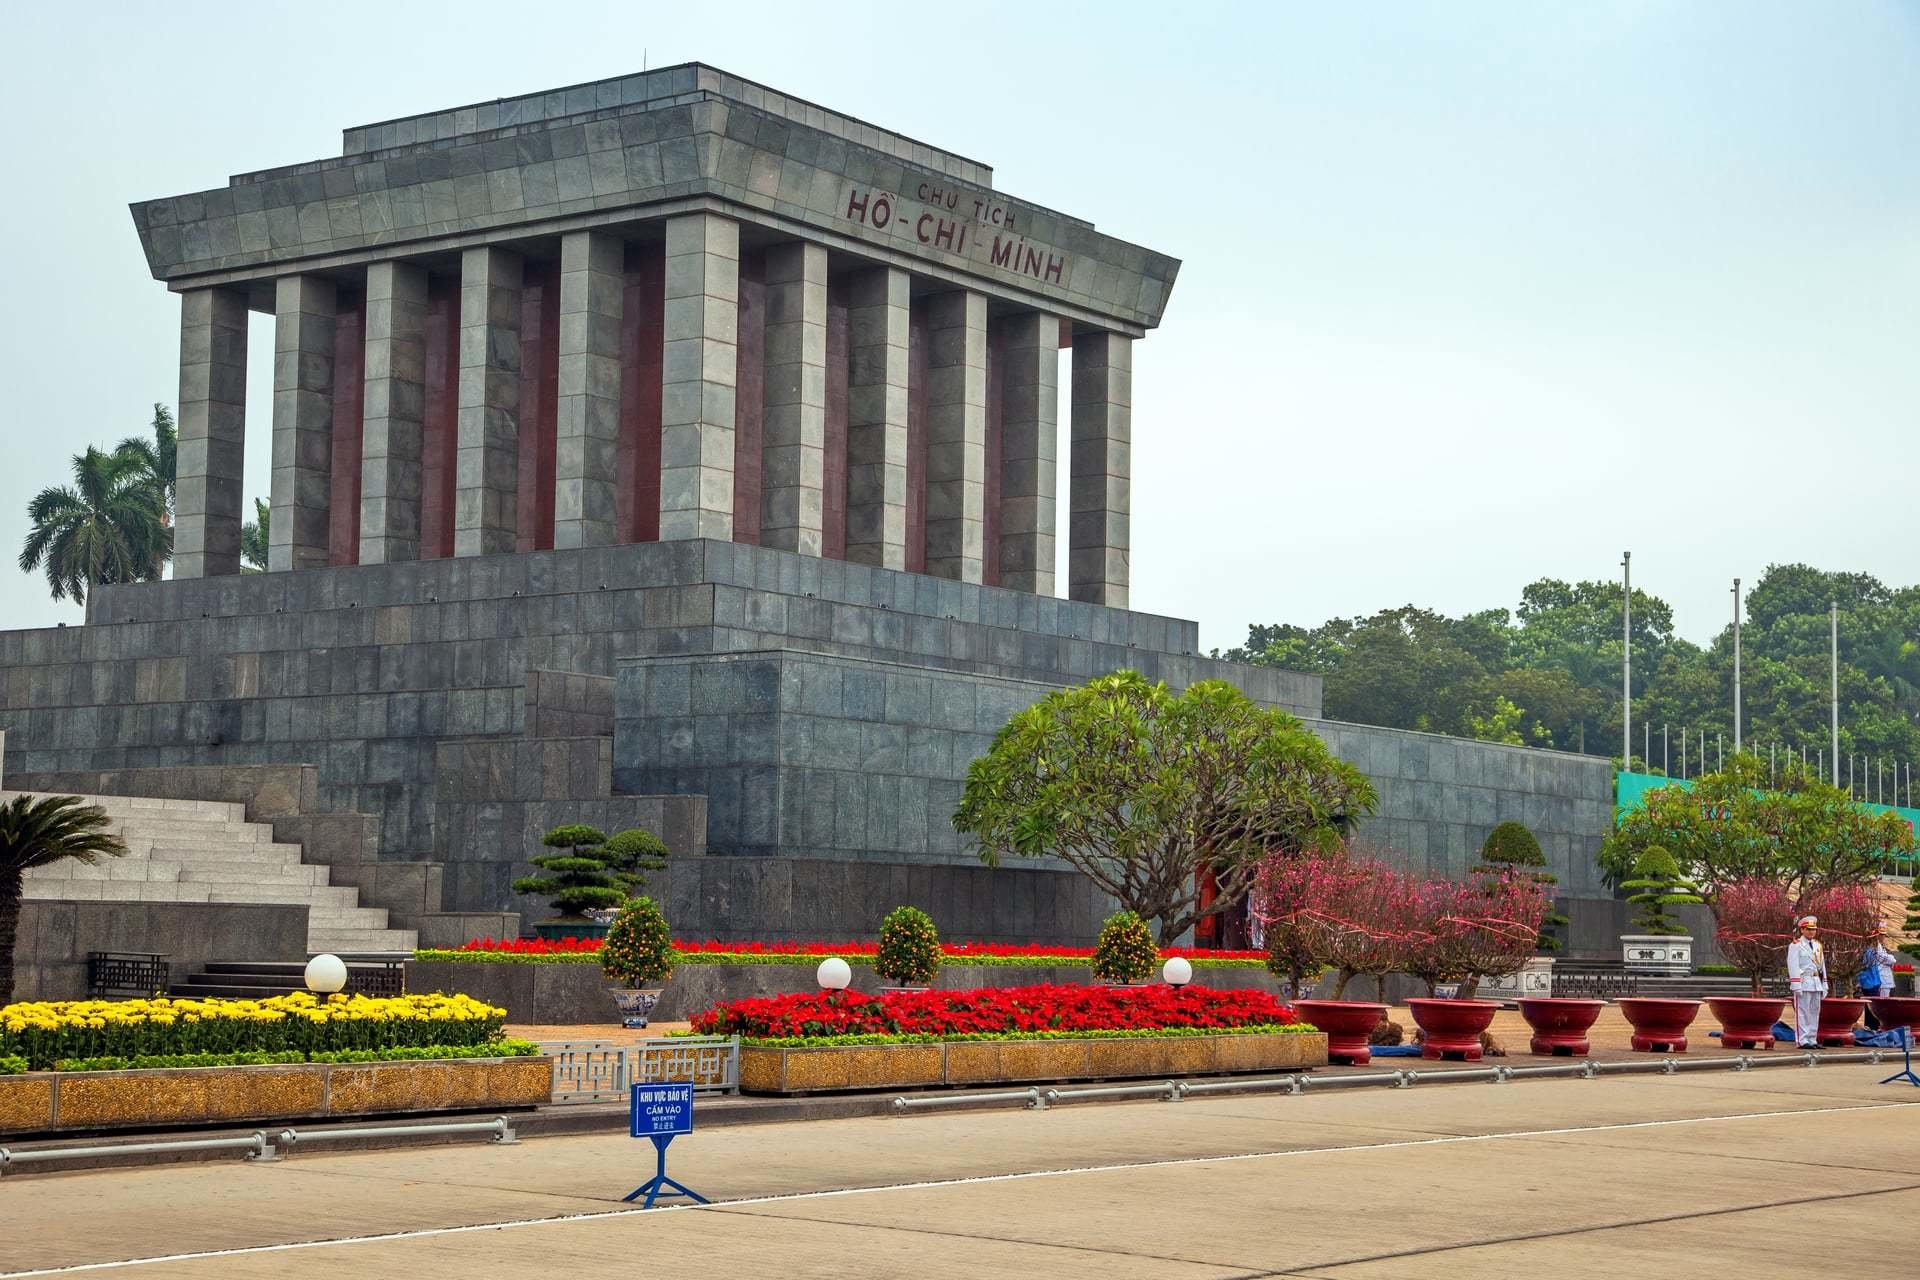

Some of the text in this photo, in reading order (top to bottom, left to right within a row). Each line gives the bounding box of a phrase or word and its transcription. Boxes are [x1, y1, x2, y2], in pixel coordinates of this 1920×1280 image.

[846, 189, 896, 229] HỒ
[640, 1091, 653, 1103] KHU
[654, 1089, 666, 1104] VỰC
[667, 1087, 680, 1101] BẢO
[646, 1104, 681, 1115] CẤM VÀO
